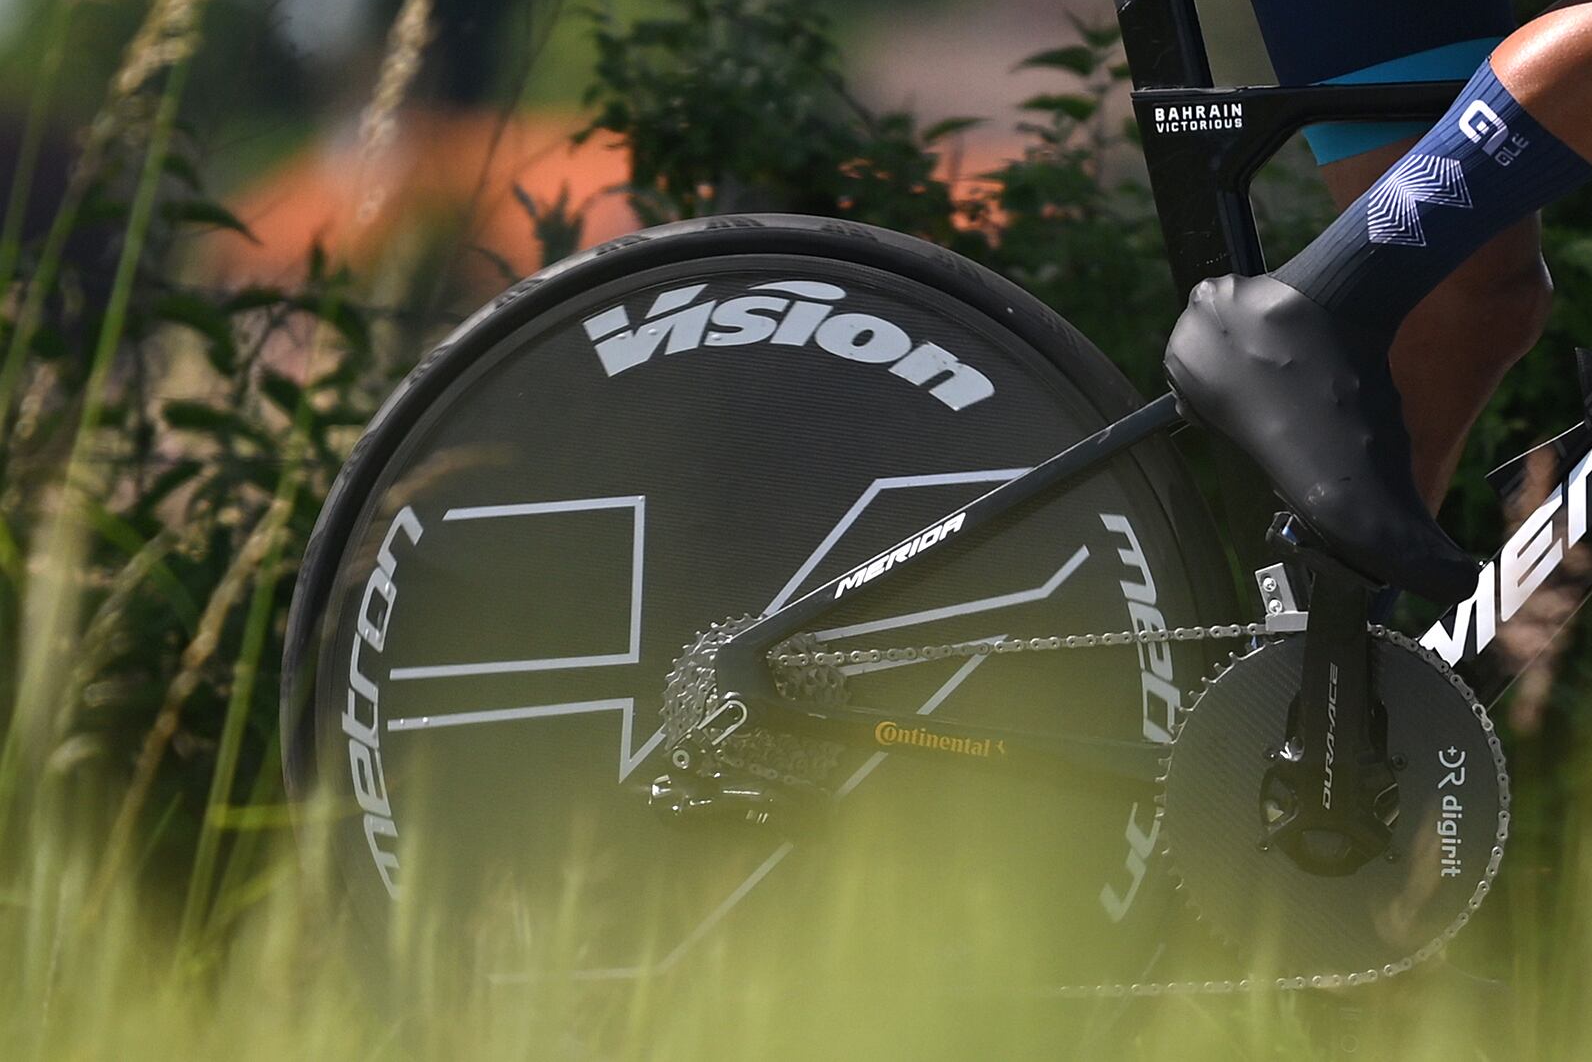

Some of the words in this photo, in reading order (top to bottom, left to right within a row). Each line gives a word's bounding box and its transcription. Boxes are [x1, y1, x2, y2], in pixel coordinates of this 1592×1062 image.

[1154, 102, 1243, 122] BAHRAIN
[1155, 118, 1243, 134] VICTORIOUS
[581, 279, 996, 412] Vision
[834, 511, 967, 600] MERIDA
[341, 505, 424, 901] metron
[874, 720, 991, 758] Continental
[1321, 661, 1338, 810] DURA-ACE
[1436, 794, 1463, 878] digirit
